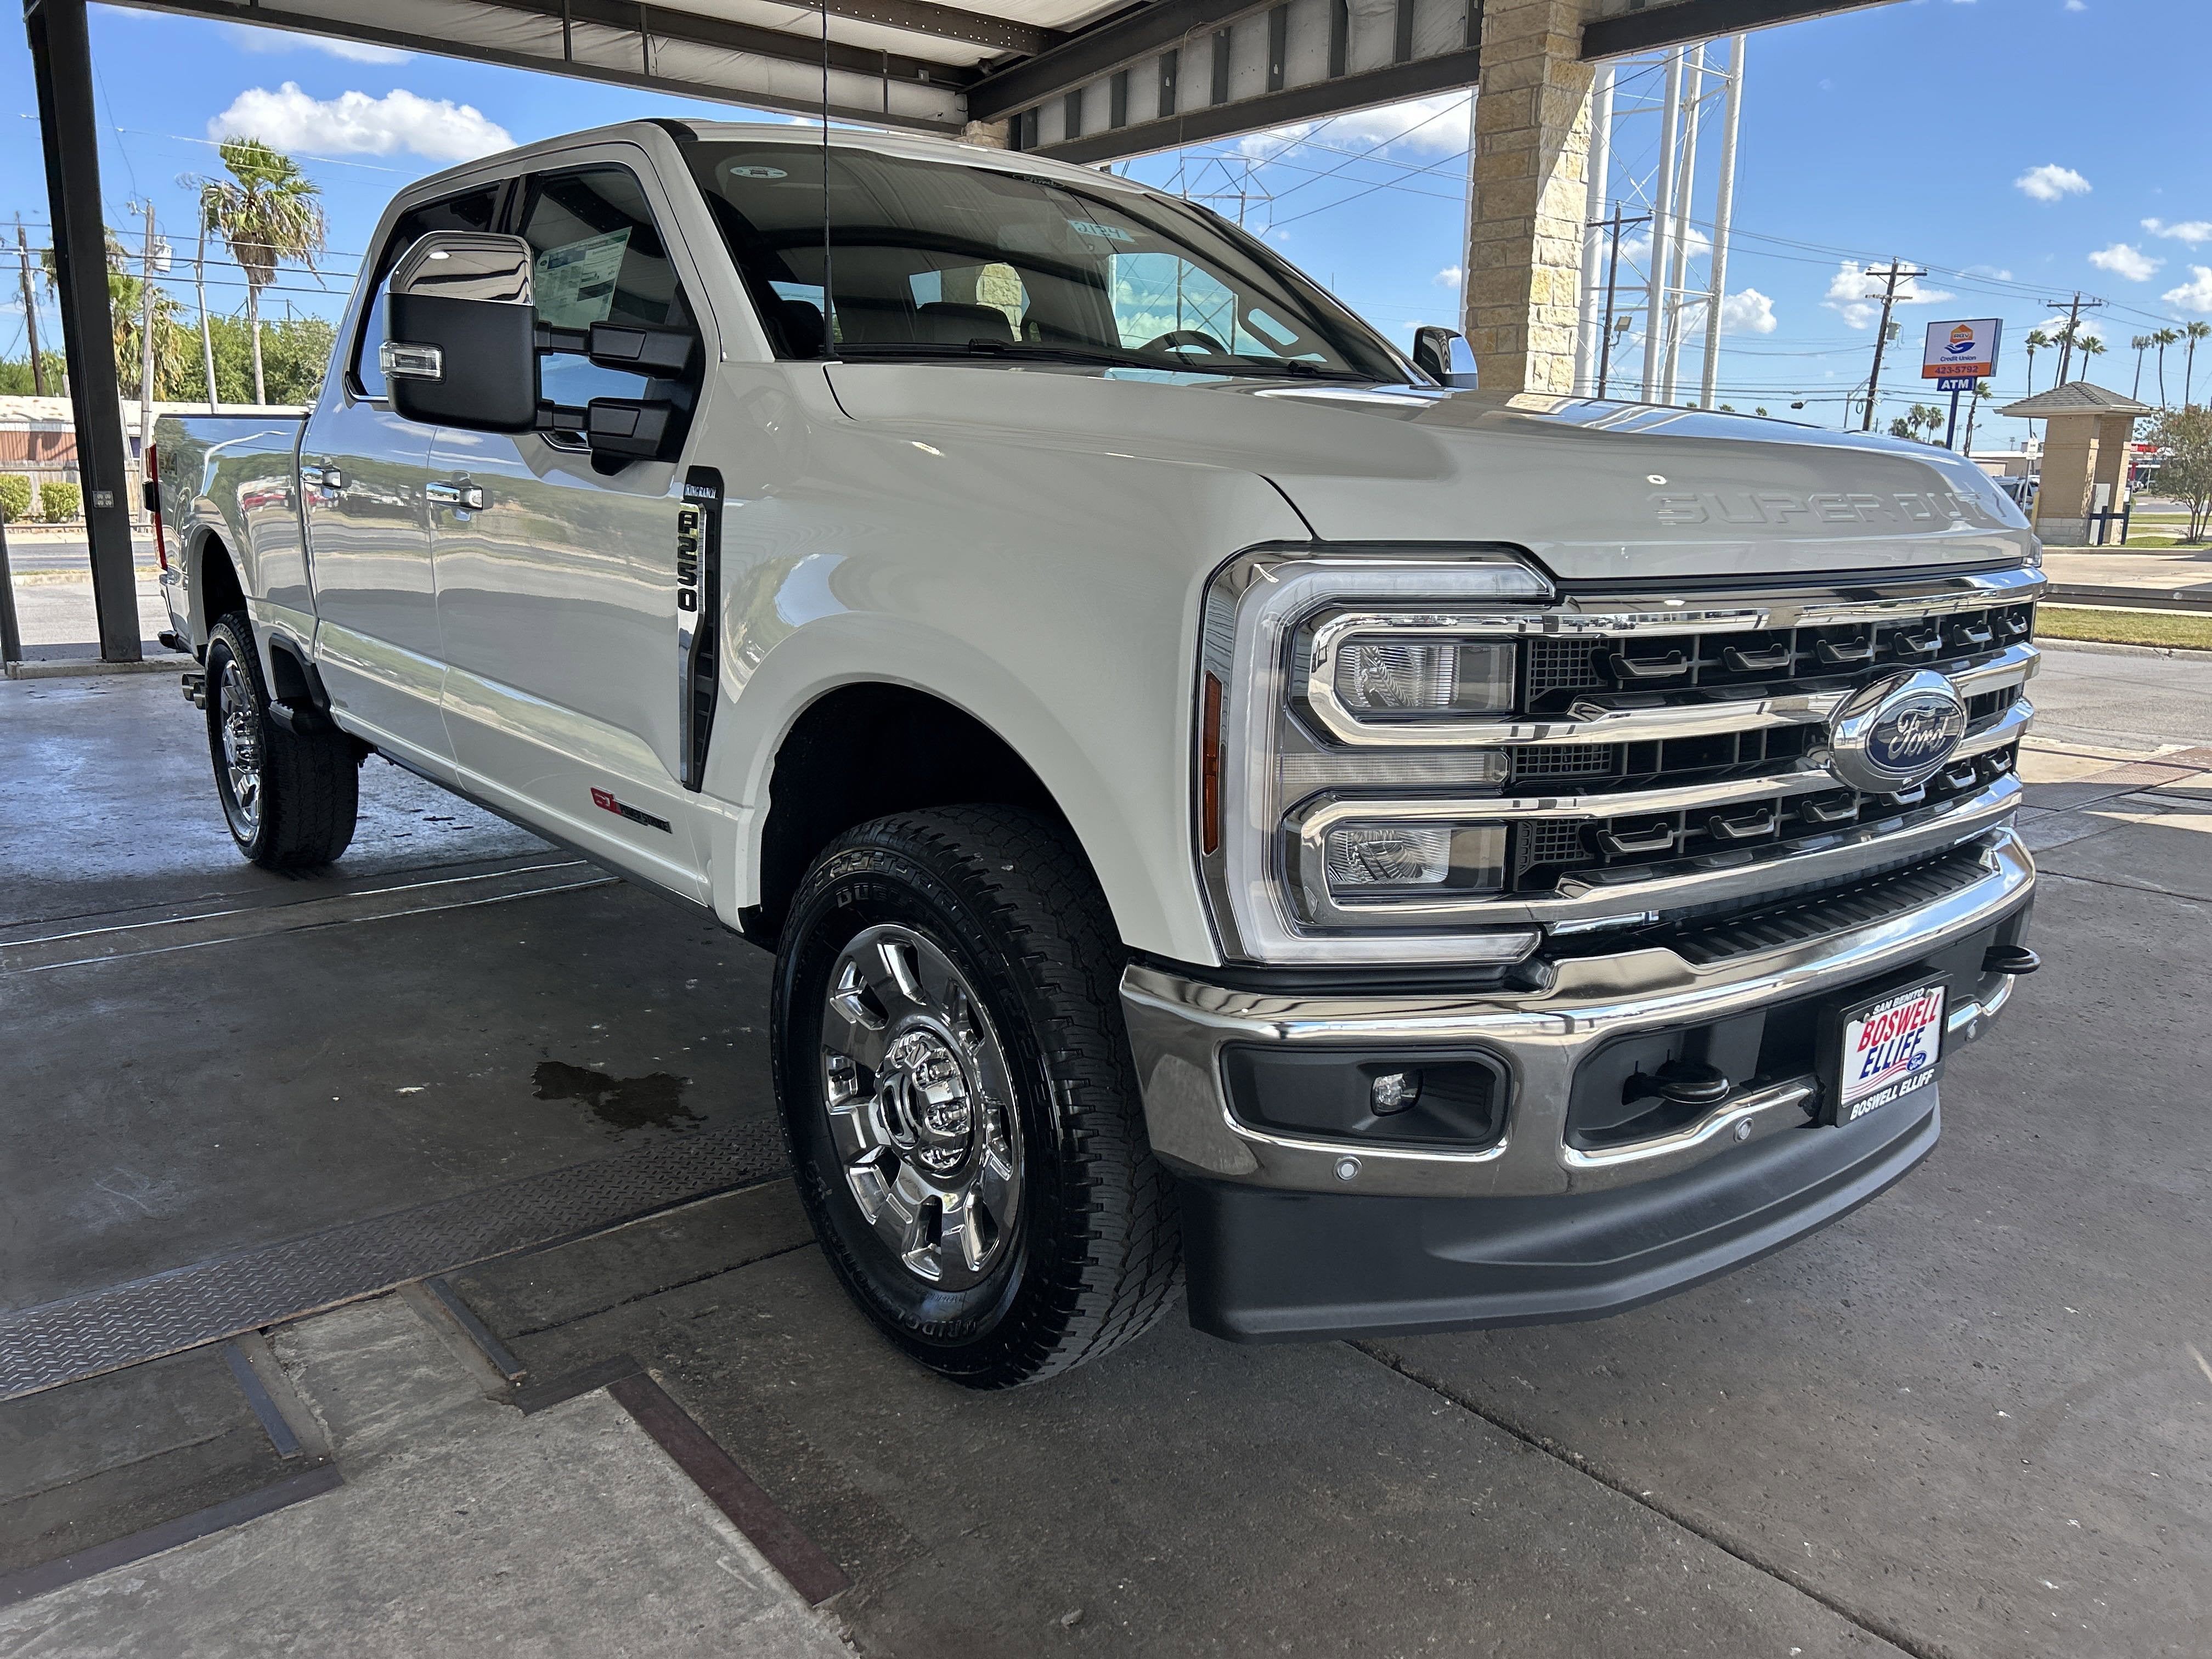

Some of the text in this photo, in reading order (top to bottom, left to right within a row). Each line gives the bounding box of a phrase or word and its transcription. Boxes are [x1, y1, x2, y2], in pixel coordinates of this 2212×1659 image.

[1935, 365, 1978, 374] 423-5792
[1941, 379, 1970, 390] ATM
[1647, 493, 1898, 526] SUPER
[1887, 708, 1949, 760] Ford
[1872, 987, 1926, 1015] SAN BENITO
[1856, 993, 1940, 1053] BOSWELL
[1858, 1025, 1926, 1080] ELLIFF
[1849, 1068, 1935, 1120] BOSWELL ELLIFF
